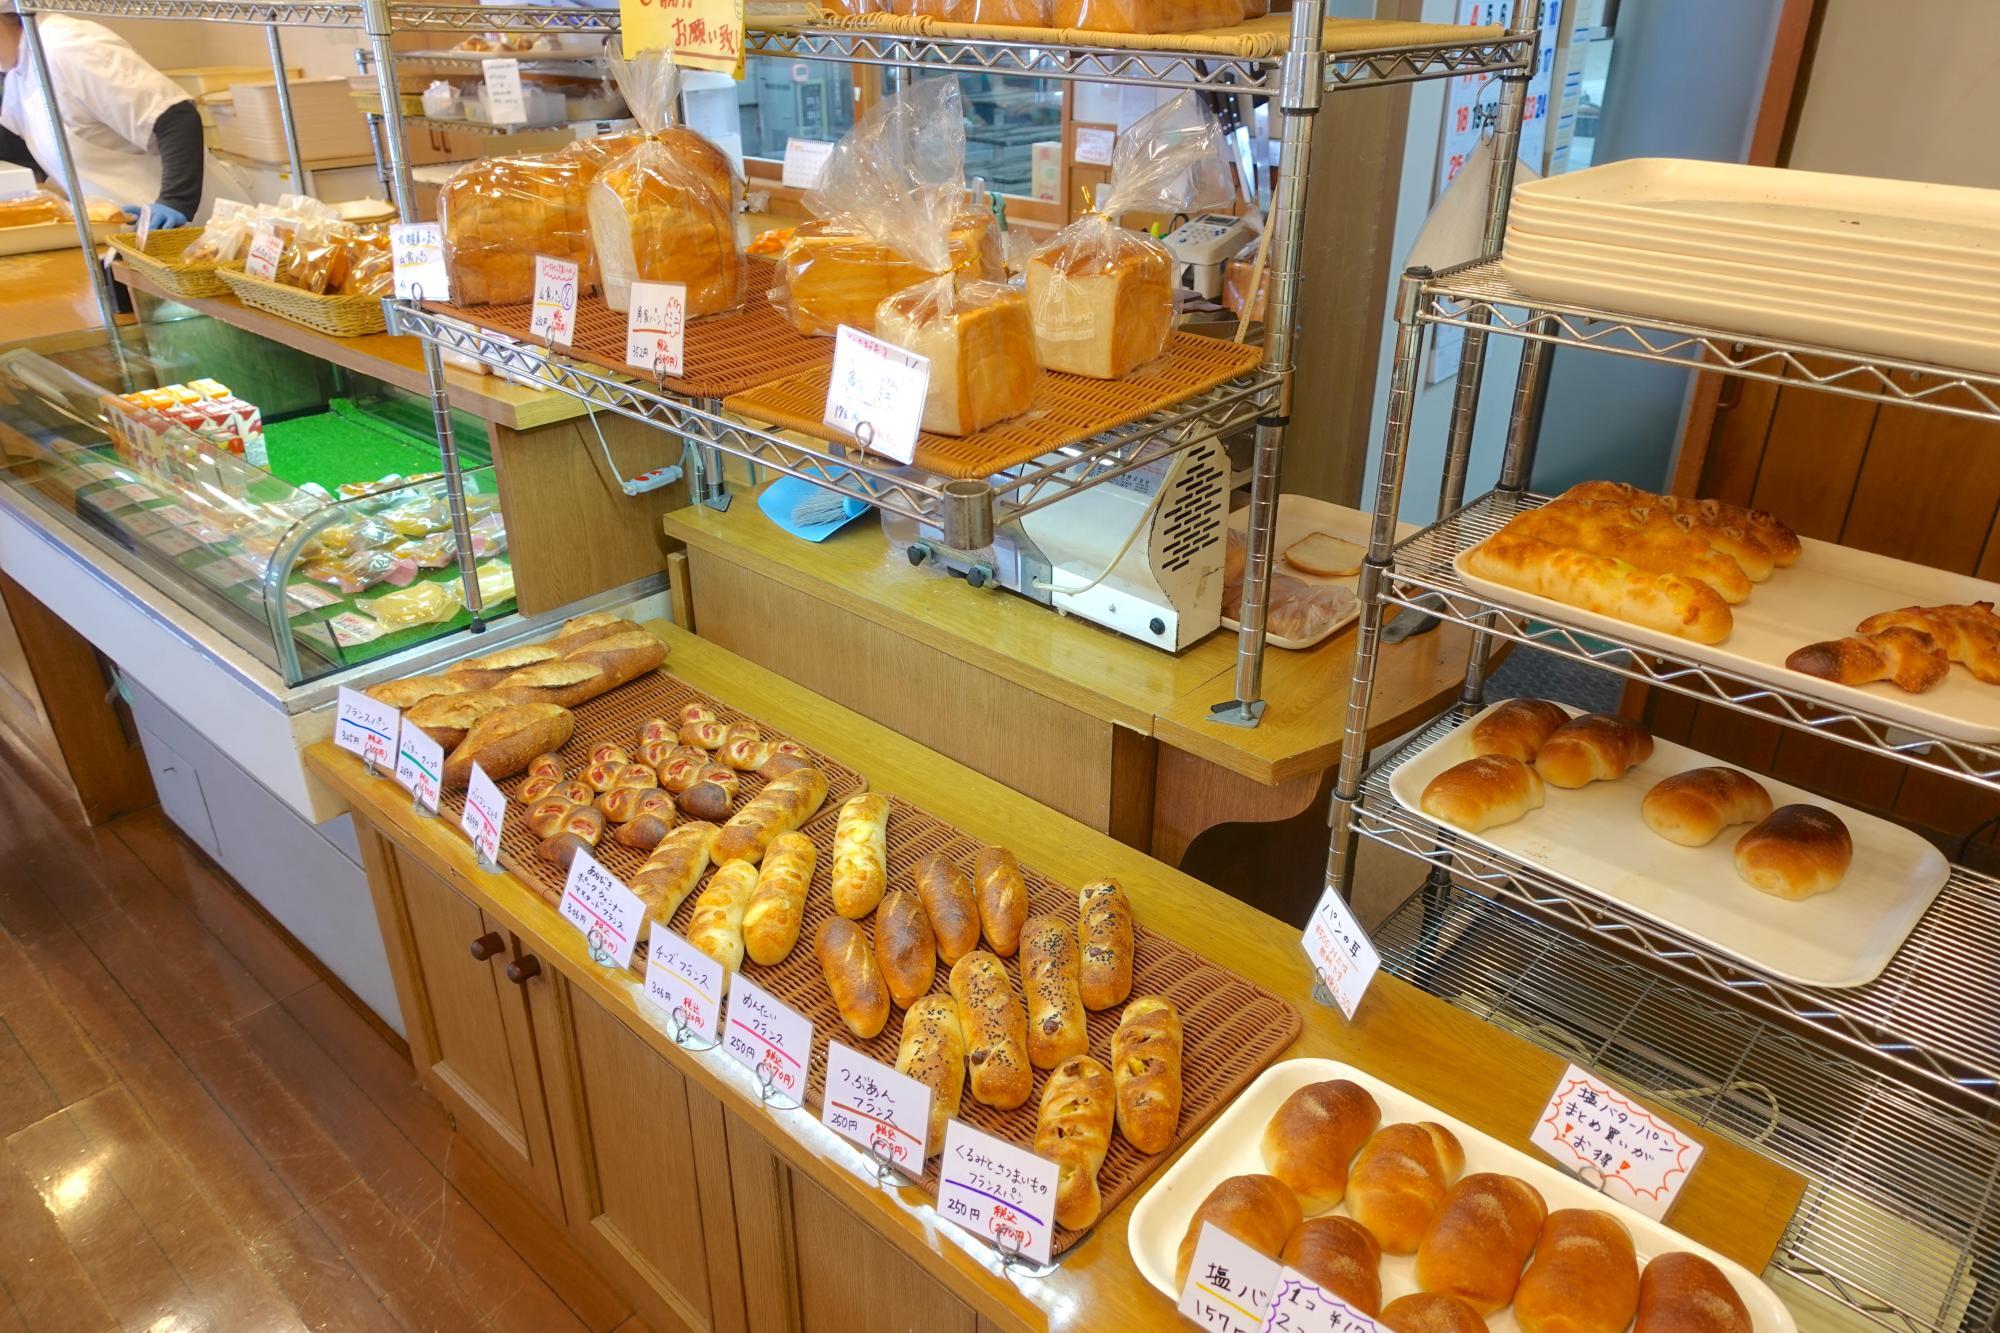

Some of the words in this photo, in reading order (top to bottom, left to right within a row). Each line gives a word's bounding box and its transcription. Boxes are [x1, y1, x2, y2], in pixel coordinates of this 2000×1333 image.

[345, 704, 390, 732] フランスパン
[587, 866, 613, 891] あらびき
[652, 981, 671, 1001] 306円
[742, 993, 777, 1020] めんたい
[752, 1019, 785, 1048] フランス
[730, 1036, 756, 1060] 250円
[840, 1068, 896, 1103] つぶあん
[831, 1112, 858, 1132] 250円
[853, 1096, 899, 1129] フランス
[1577, 1087, 1675, 1153] 塩バターパン
[875, 1123, 897, 1142] 税込
[1565, 1102, 1655, 1162] まとめ買いが
[1573, 1135, 1613, 1168] お得
[969, 1173, 1024, 1206] フランスパン
[947, 1198, 980, 1221] 250円
[993, 1204, 1018, 1225] 税込
